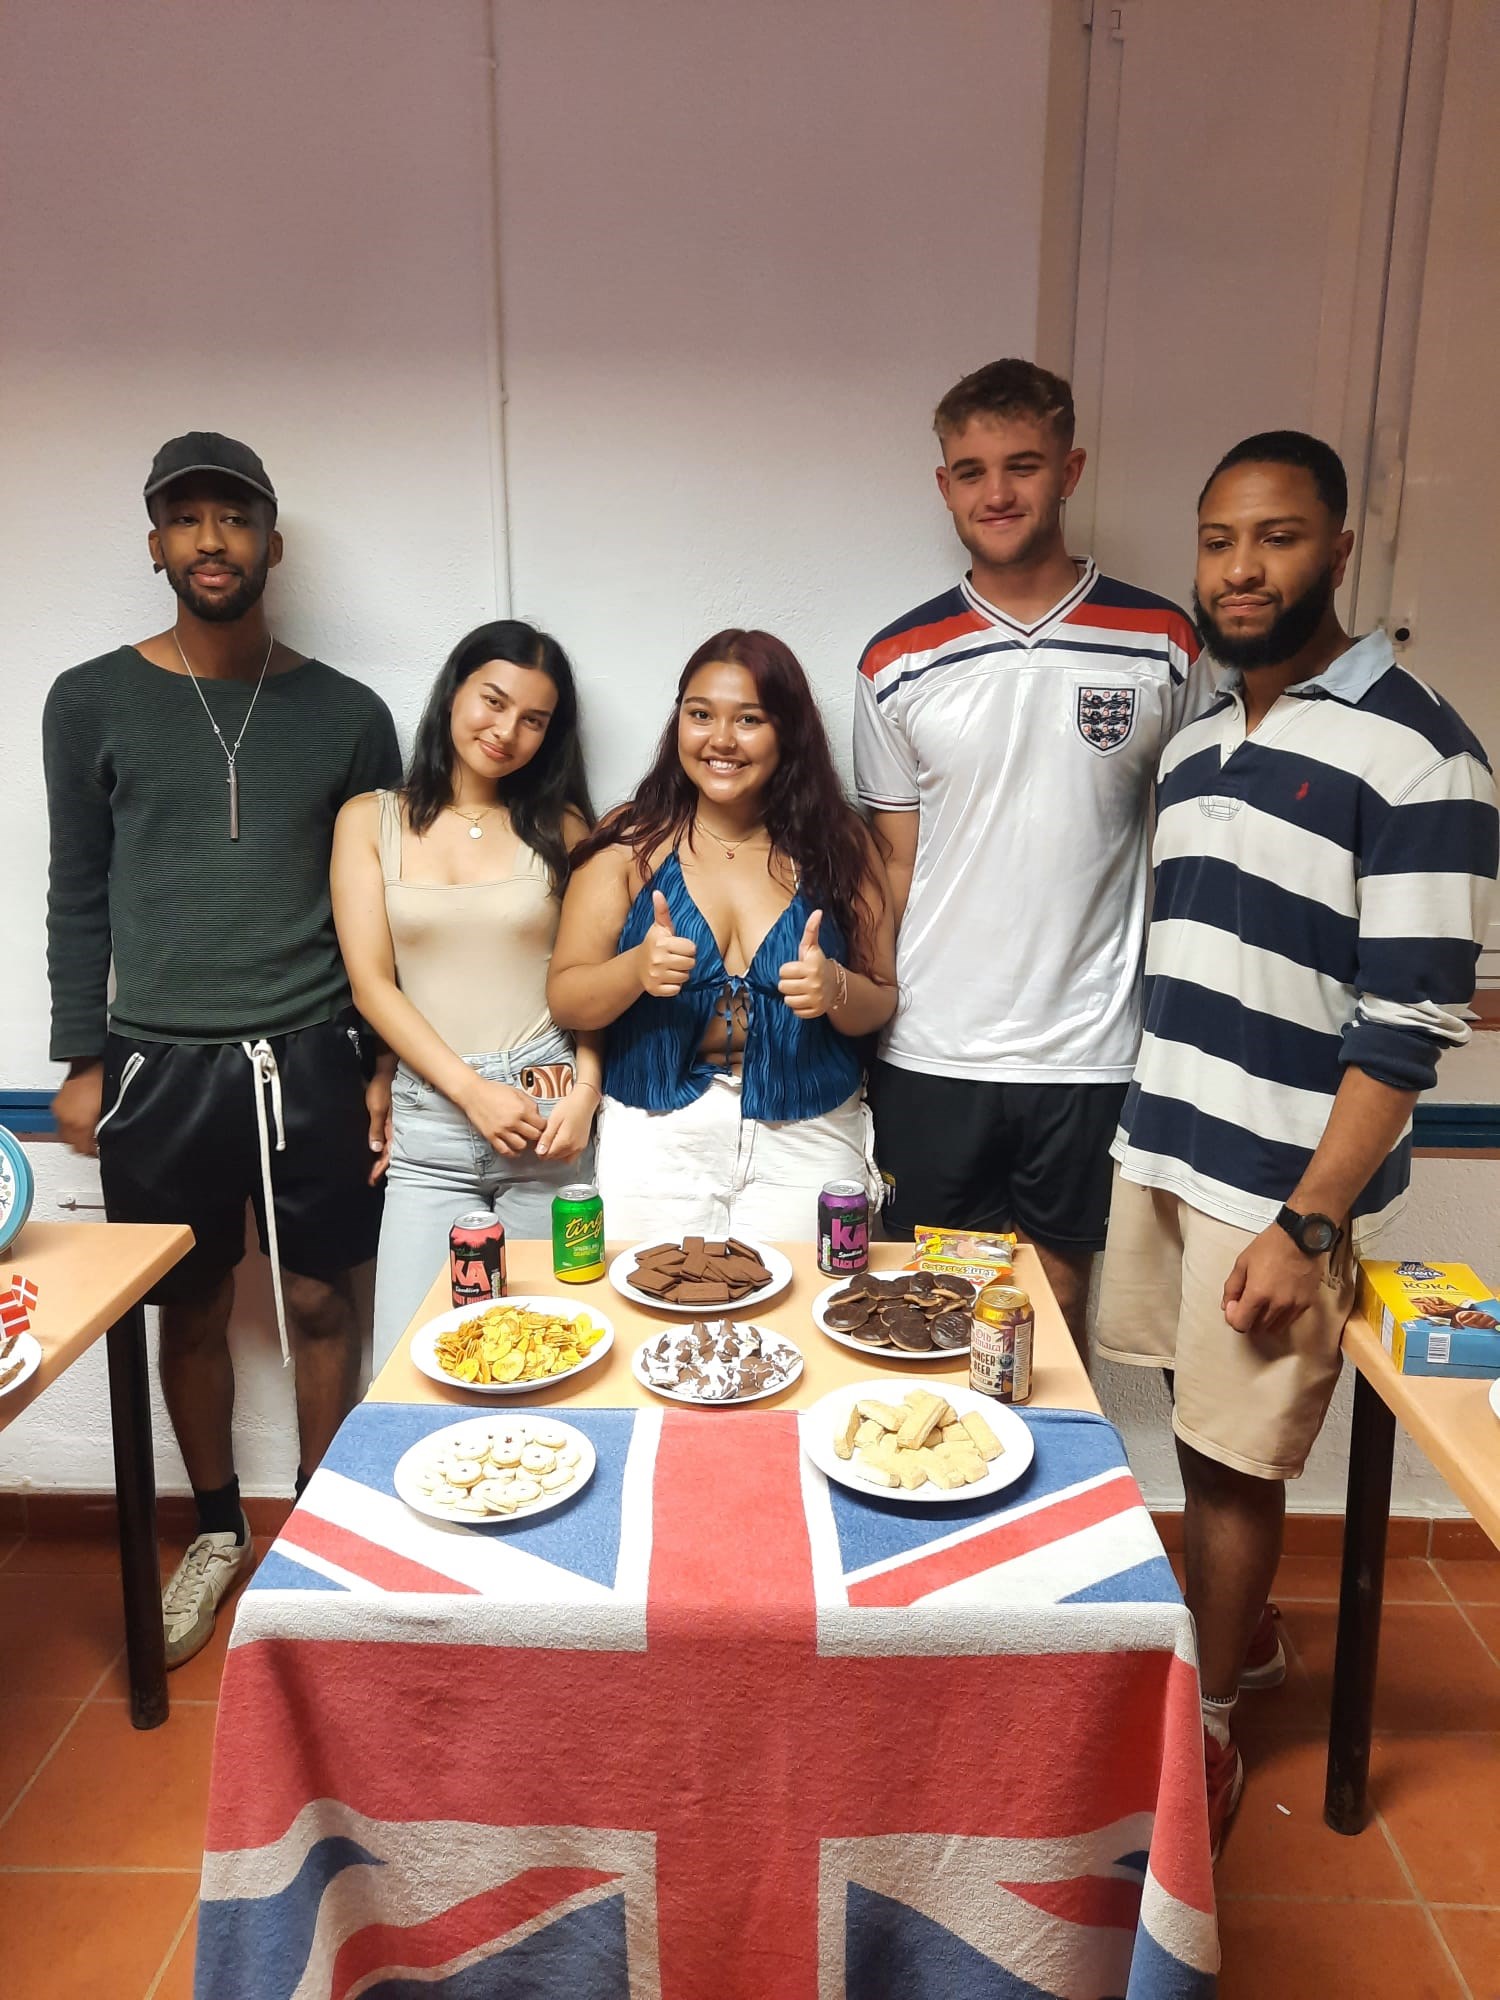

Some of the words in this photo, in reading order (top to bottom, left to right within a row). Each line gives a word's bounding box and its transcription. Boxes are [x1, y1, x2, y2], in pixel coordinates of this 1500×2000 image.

[831, 1218, 868, 1252] KA
[451, 1249, 492, 1292] KA
[1403, 1282, 1458, 1290] KOKA
[972, 1346, 996, 1367] GINGER
[974, 1360, 991, 1376] BEER
